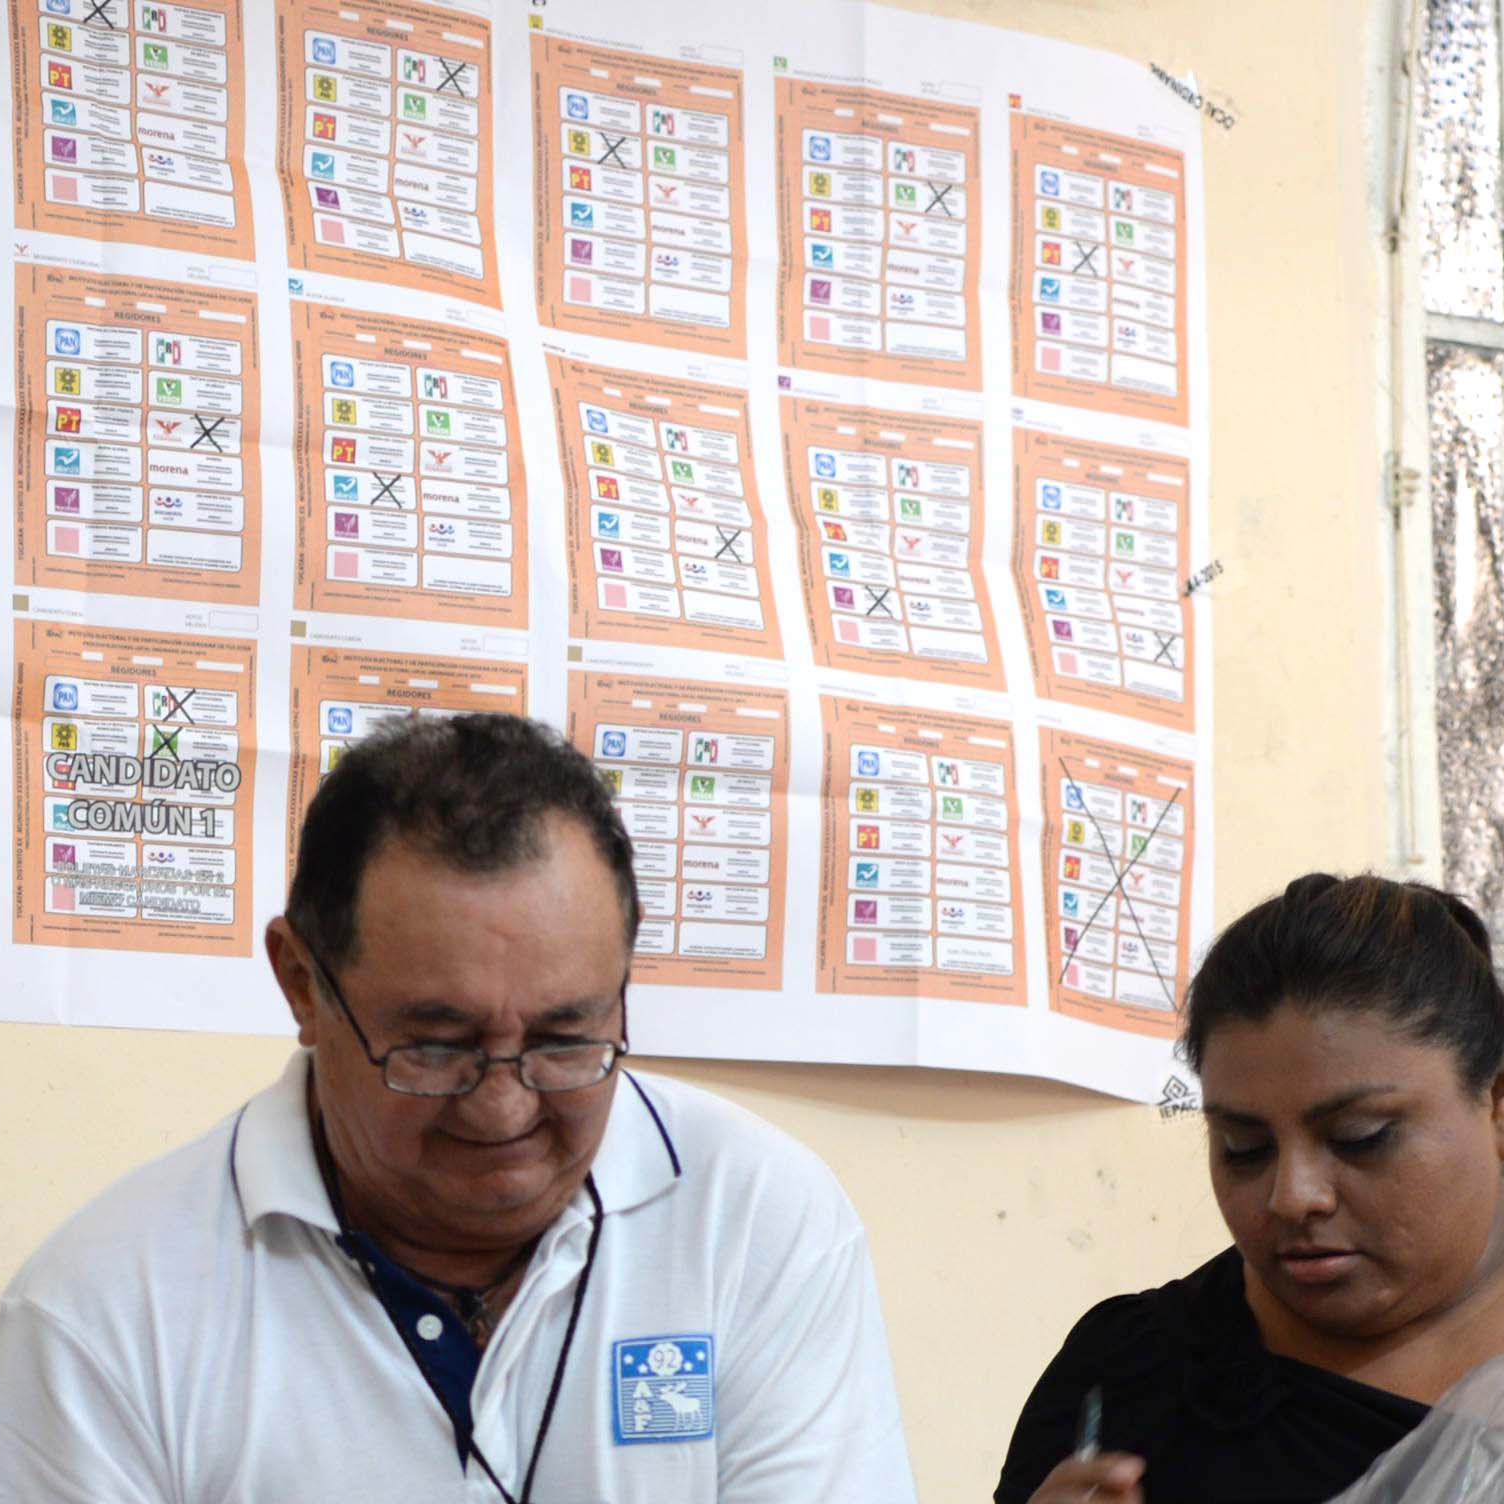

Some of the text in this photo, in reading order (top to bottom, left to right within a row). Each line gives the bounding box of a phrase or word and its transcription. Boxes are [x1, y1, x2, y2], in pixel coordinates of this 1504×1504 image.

[138, 126, 175, 141] morena
[113, 311, 161, 325] REGIDORES
[149, 462, 188, 476] morena
[46, 751, 242, 793] CANDIDATO
[66, 798, 216, 838] COMÚN 1
[1160, 1098, 1198, 1119] IEPAC
[653, 1348, 677, 1370] 92
